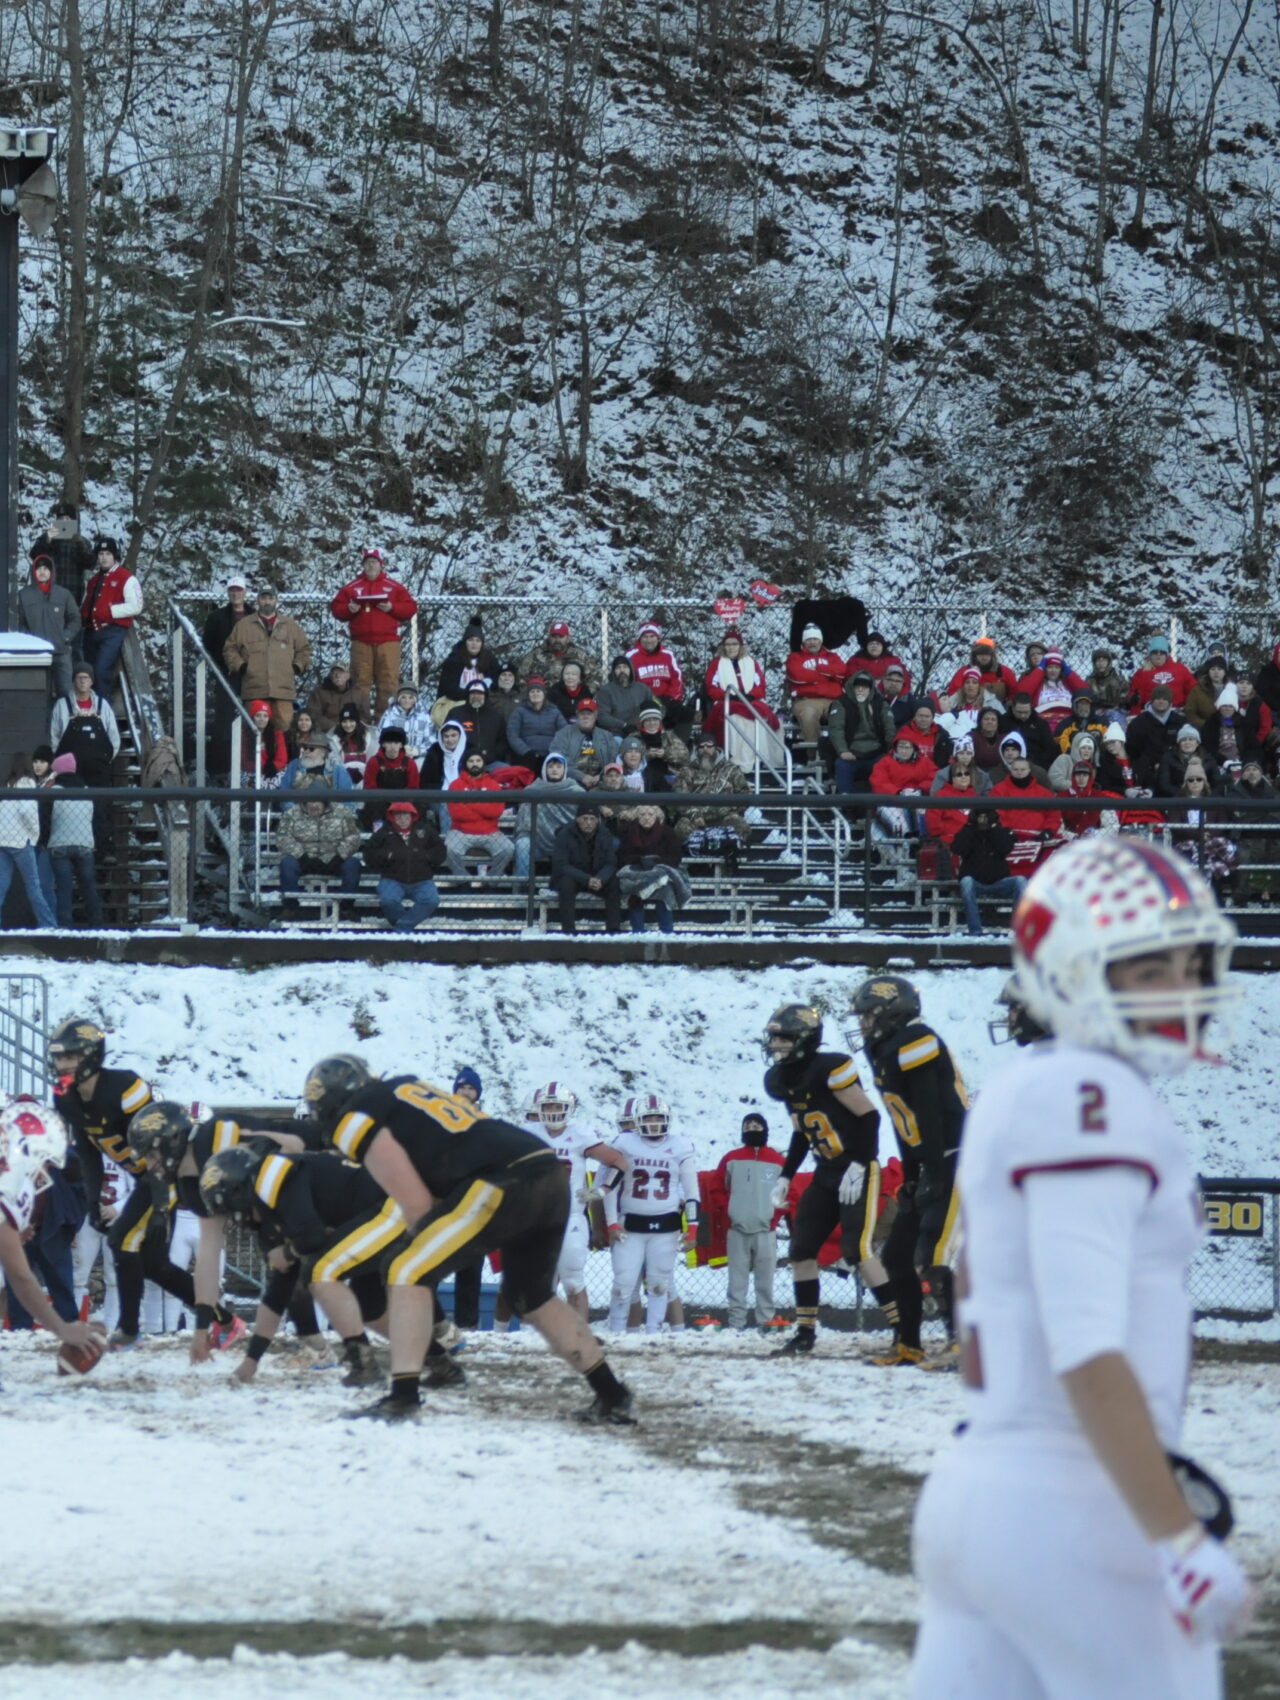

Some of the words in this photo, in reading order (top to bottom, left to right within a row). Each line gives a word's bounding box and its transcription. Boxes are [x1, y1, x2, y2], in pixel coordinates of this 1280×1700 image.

[1078, 1082, 1107, 1133] 2
[632, 1168, 670, 1200] 23
[1204, 1201, 1261, 1230] 30
